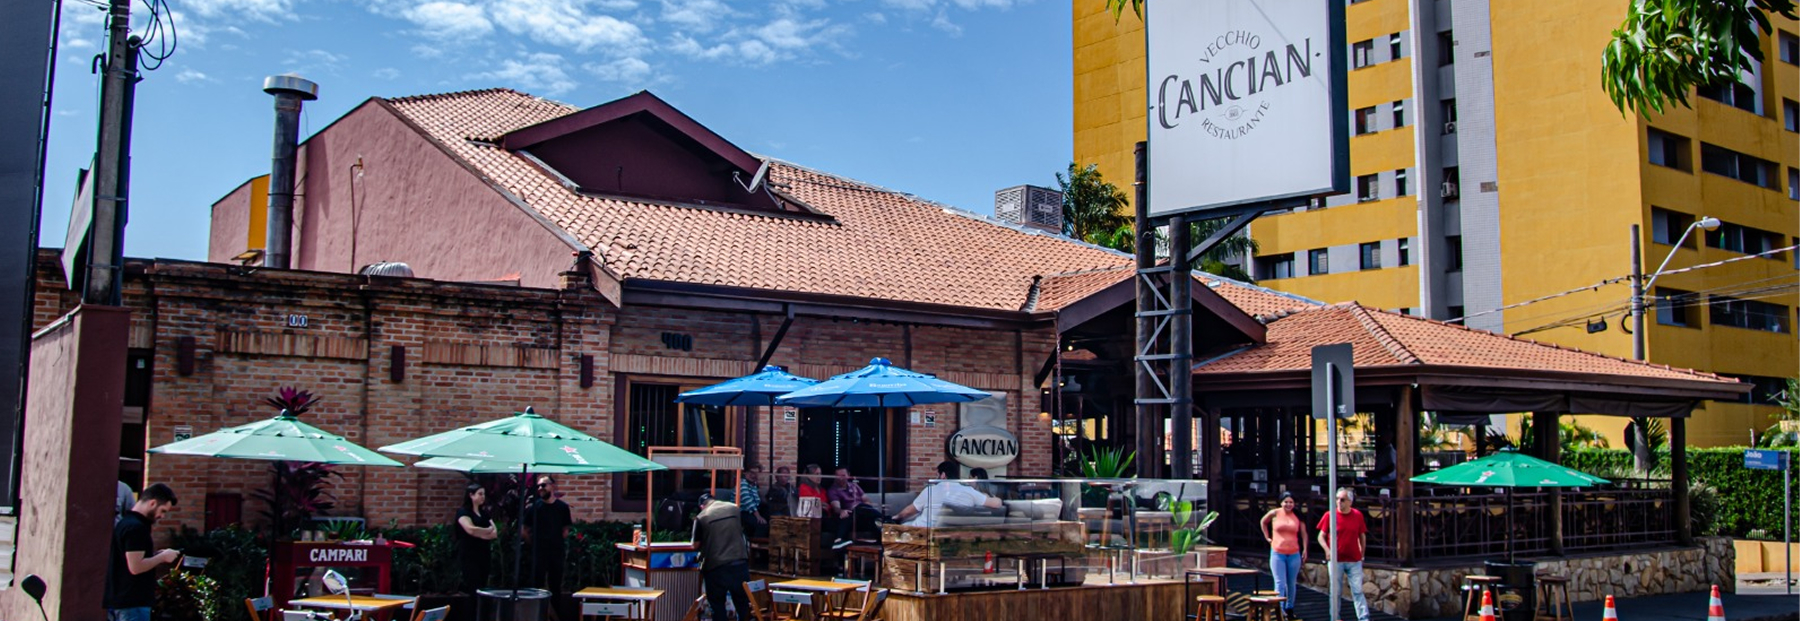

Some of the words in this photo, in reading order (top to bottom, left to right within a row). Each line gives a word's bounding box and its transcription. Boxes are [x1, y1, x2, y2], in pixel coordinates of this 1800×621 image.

[1199, 30, 1261, 64] VECCHIO
[1158, 37, 1311, 130] CANCIAN
[1201, 100, 1271, 140] RESTAURANTE
[661, 332, 693, 352] 400
[951, 434, 1017, 458] CANCIAN
[309, 548, 368, 562] CAMPARI
